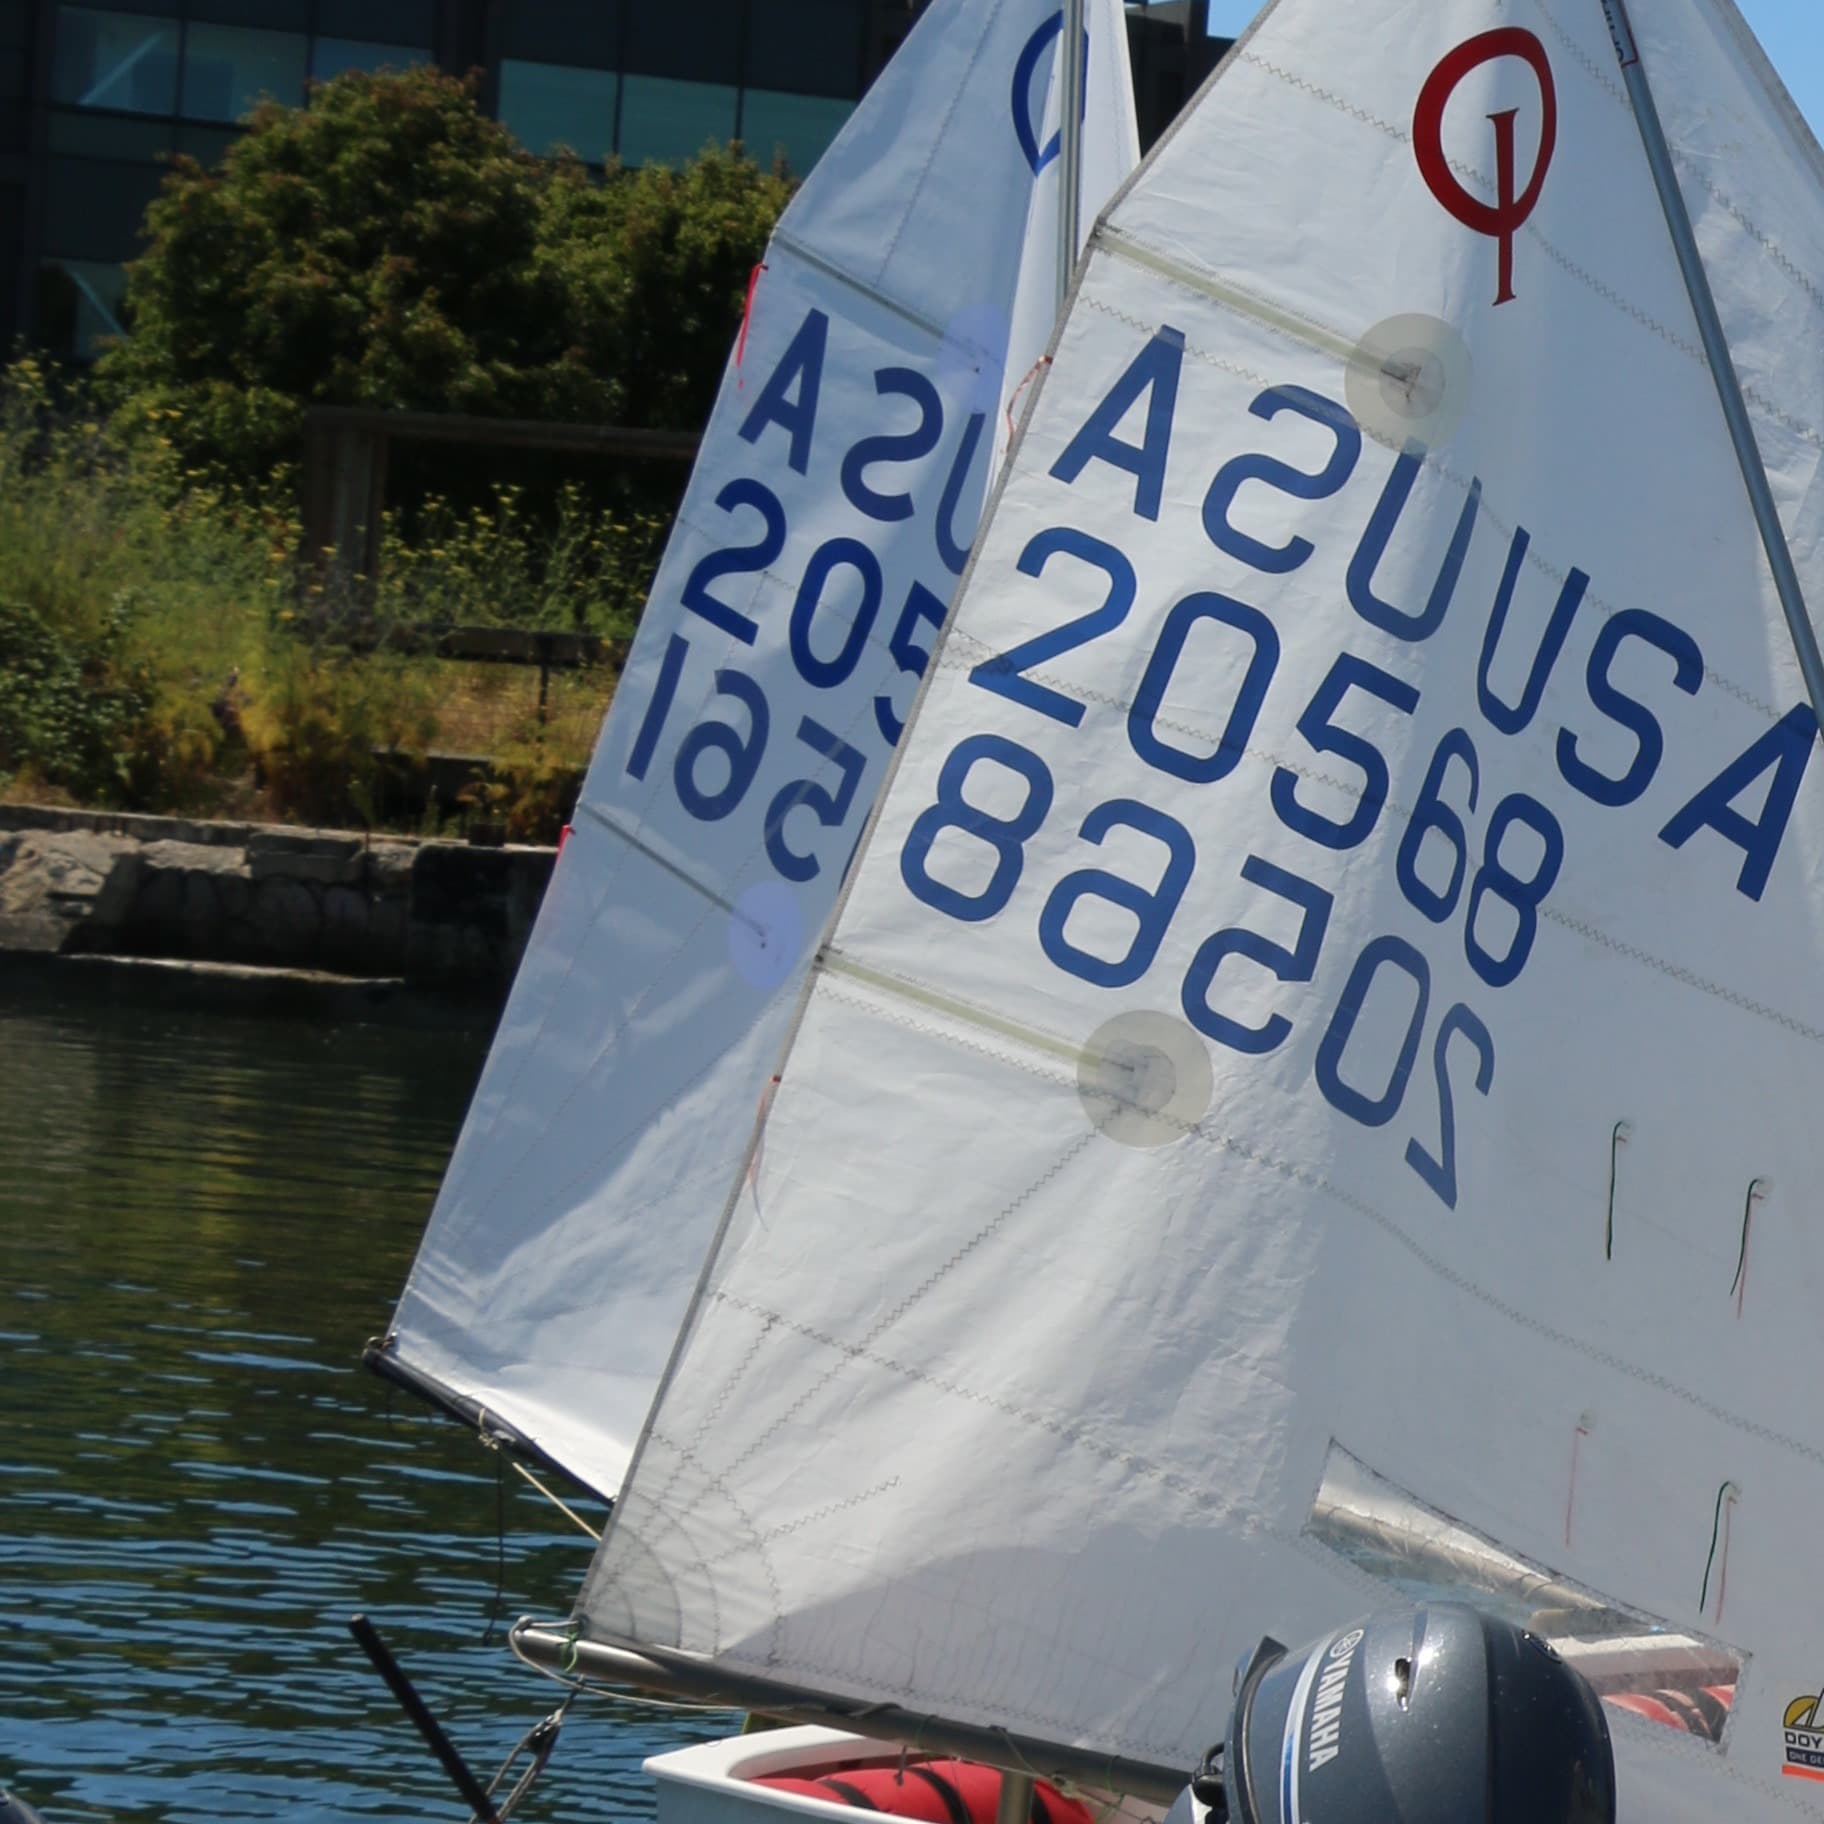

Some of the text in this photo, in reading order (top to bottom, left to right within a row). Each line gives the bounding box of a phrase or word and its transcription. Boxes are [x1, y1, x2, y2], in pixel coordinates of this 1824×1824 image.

[969, 526, 1564, 988] 20568
[1477, 526, 1819, 902] USA
[1309, 1649, 1355, 1772] YAMAHA
